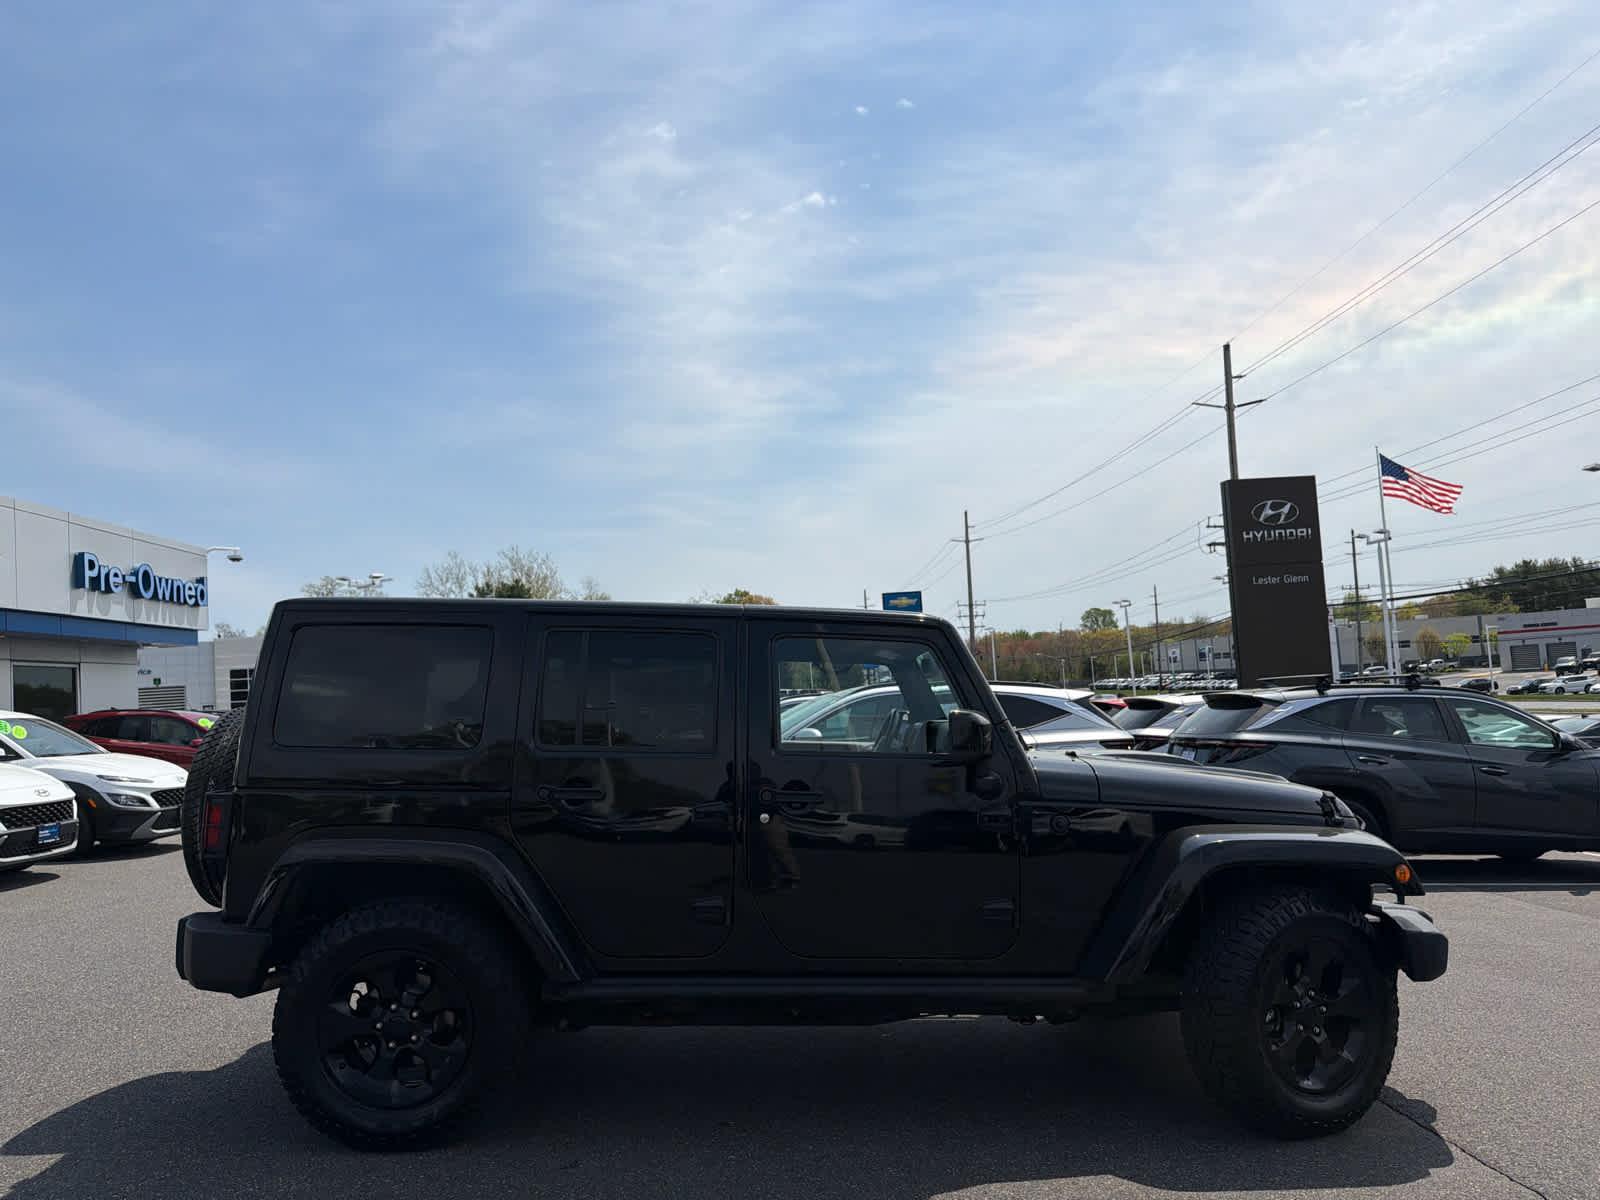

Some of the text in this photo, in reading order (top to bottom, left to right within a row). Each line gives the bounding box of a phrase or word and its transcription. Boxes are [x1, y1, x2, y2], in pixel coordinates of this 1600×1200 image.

[1243, 527, 1312, 543] HYUNDAI
[74, 551, 208, 607] Pre-Owned
[1252, 574, 1310, 585] Lester Glenn
